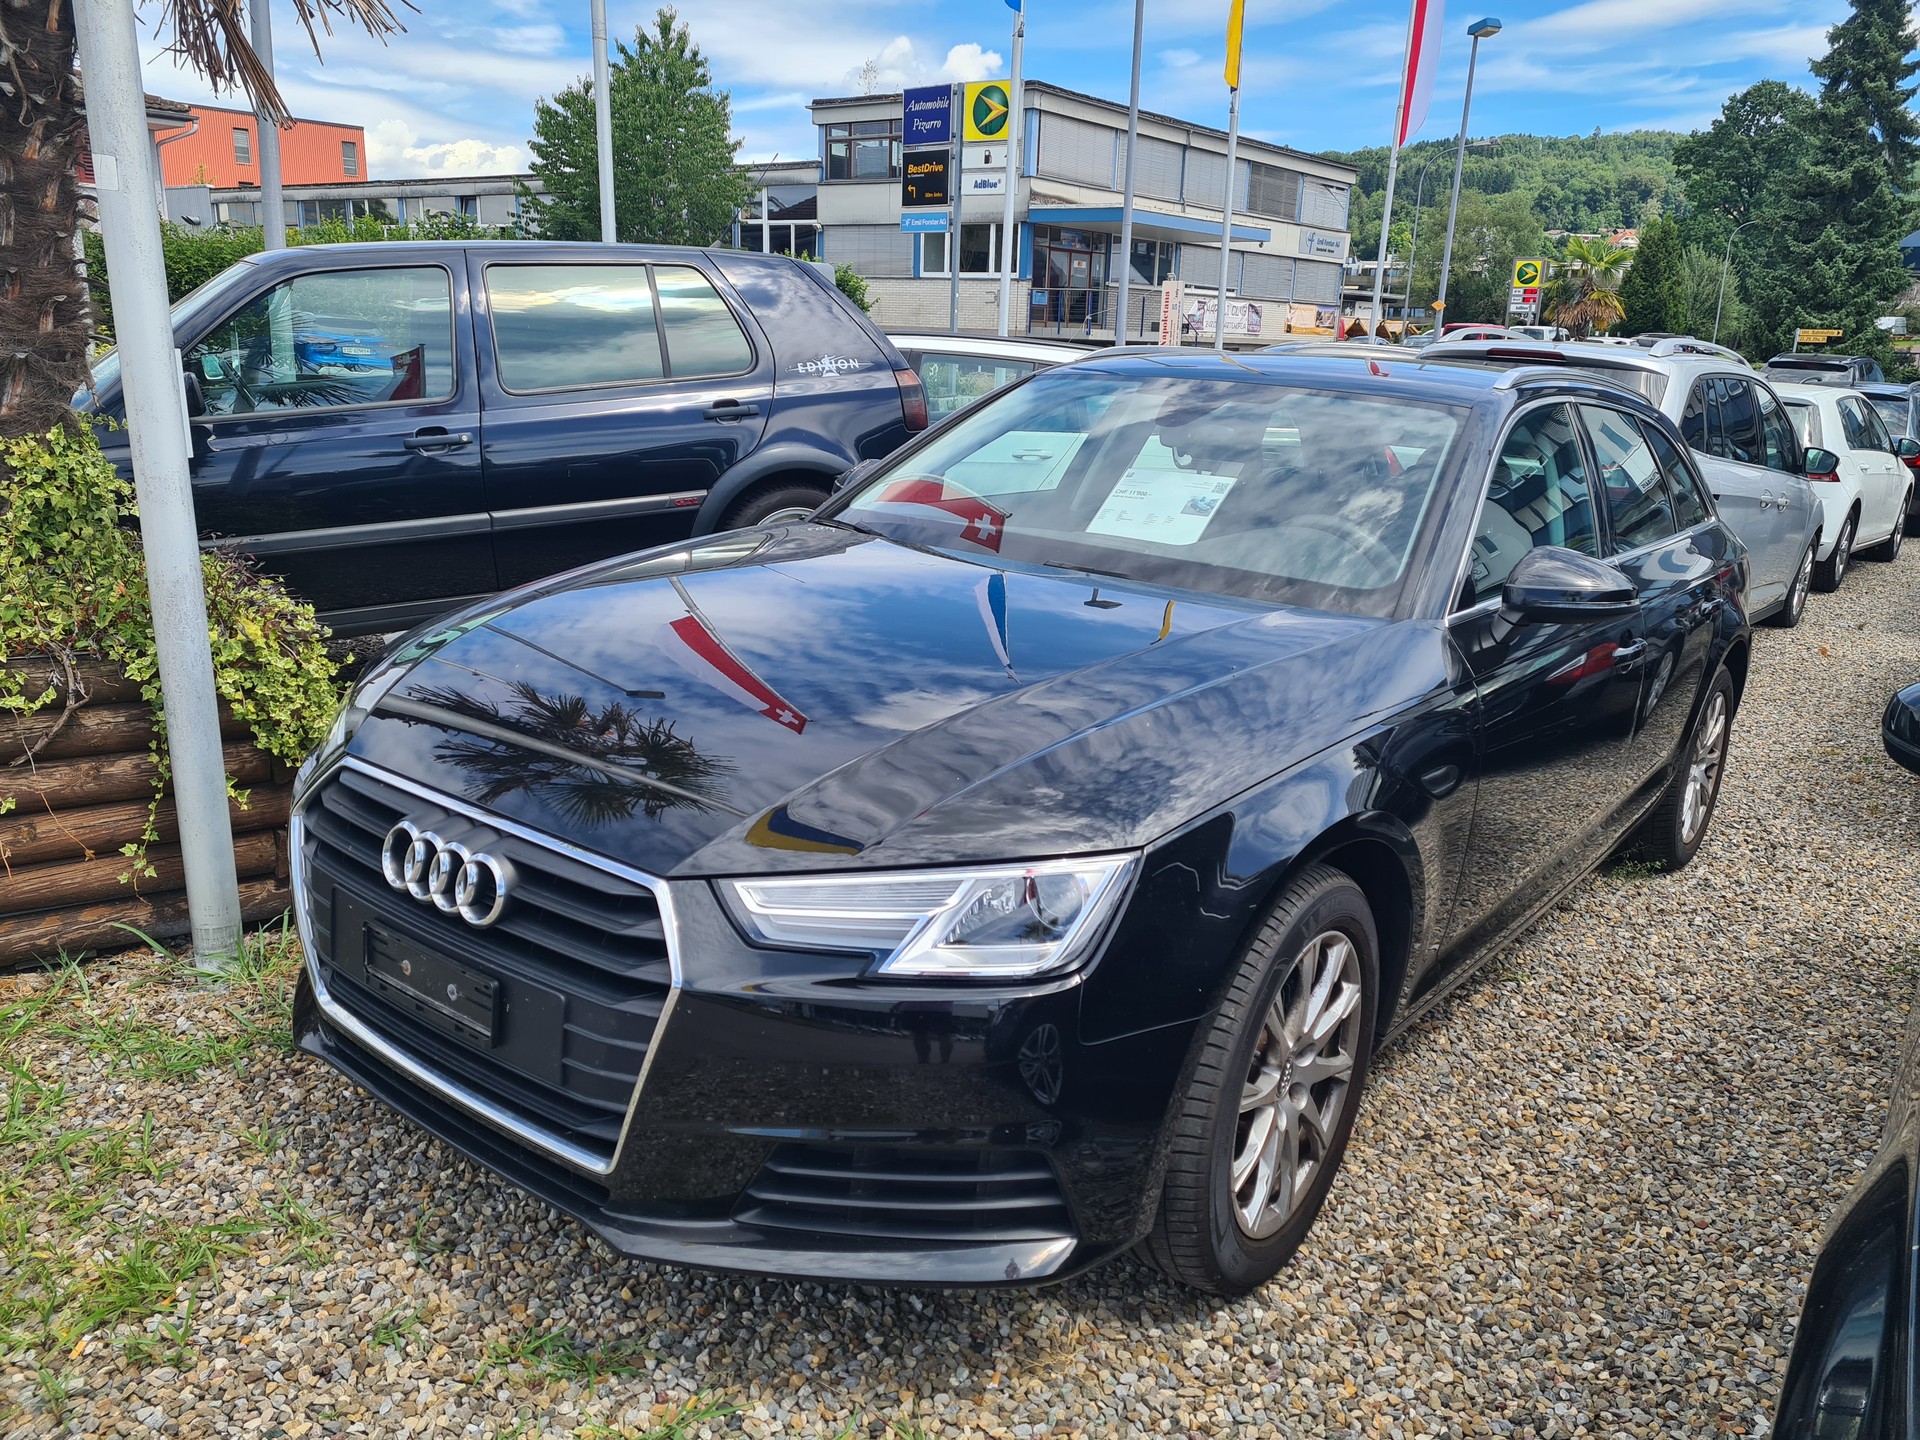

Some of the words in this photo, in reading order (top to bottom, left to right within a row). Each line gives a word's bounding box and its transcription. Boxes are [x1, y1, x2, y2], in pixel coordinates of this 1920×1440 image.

[905, 96, 949, 112] Automobile
[912, 118, 942, 133] Pizarro
[907, 161, 944, 174] BestDrive
[797, 358, 860, 373] EDIION
